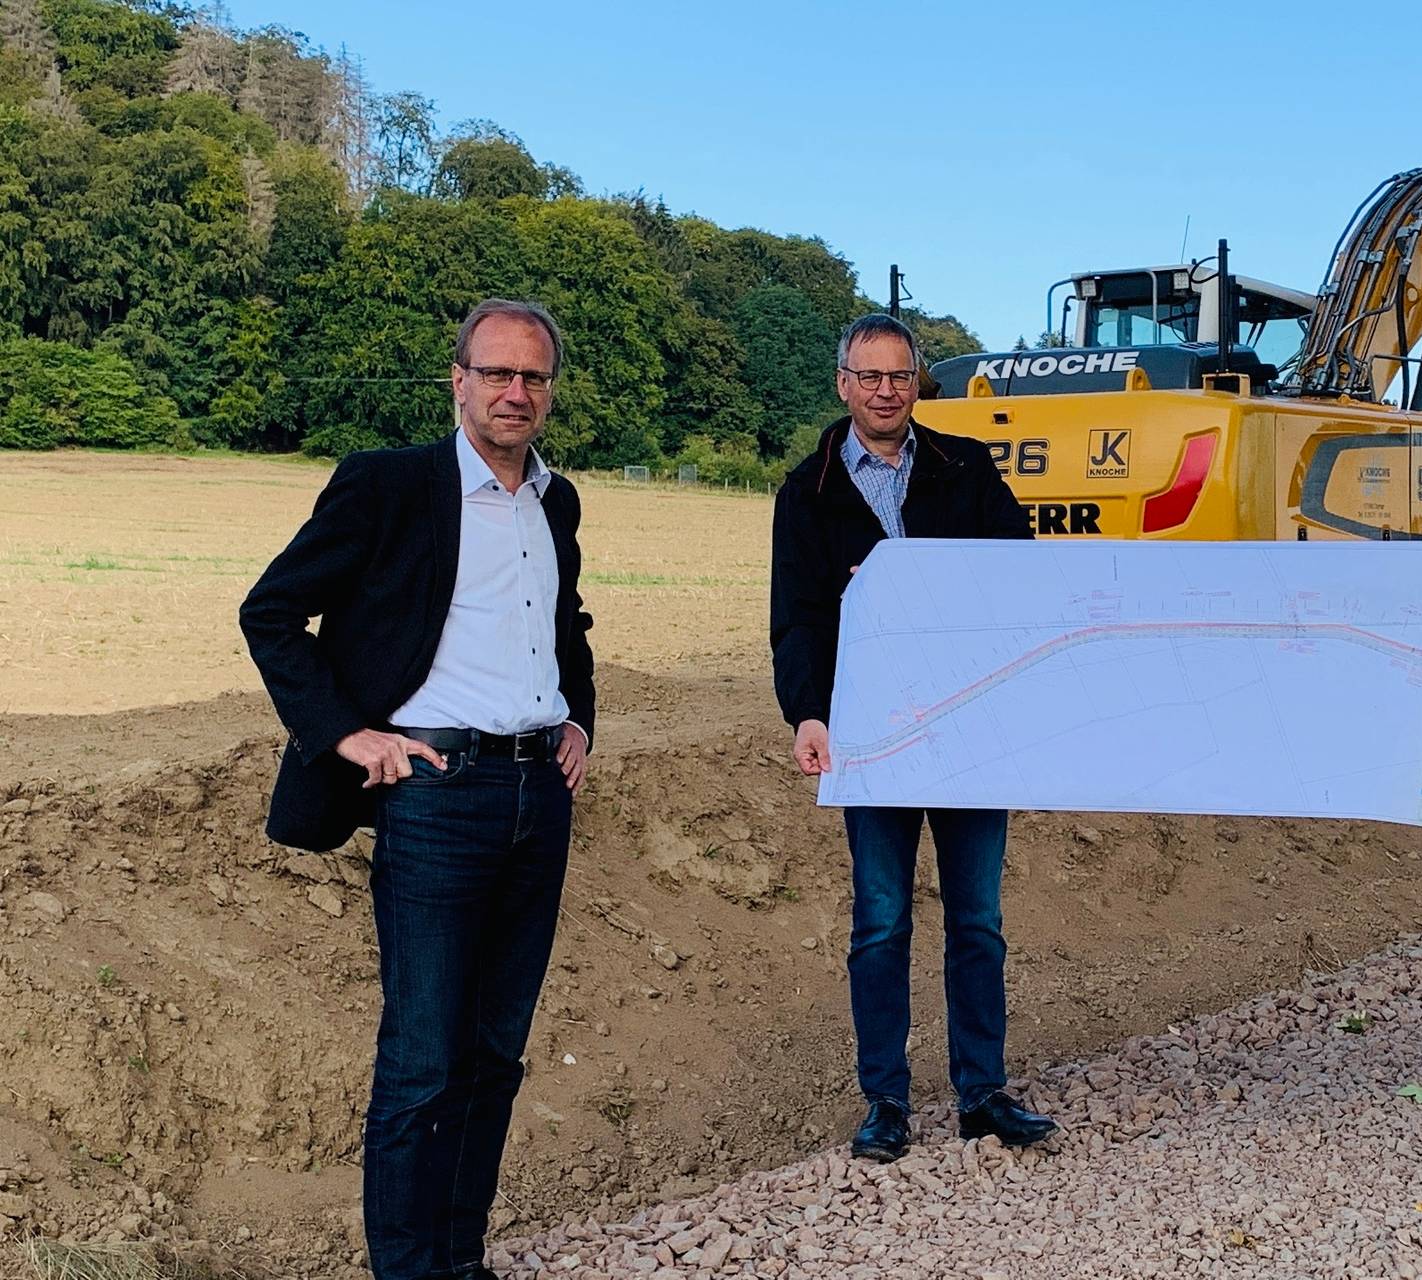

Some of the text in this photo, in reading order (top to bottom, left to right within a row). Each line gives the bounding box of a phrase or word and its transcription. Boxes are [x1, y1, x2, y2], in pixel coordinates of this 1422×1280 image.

[975, 351, 1140, 380] KNOCHE
[985, 438, 1051, 477] 26
[1090, 431, 1128, 466] JK
[1089, 468, 1127, 476] KNOCHE
[1019, 502, 1102, 534] ERR
